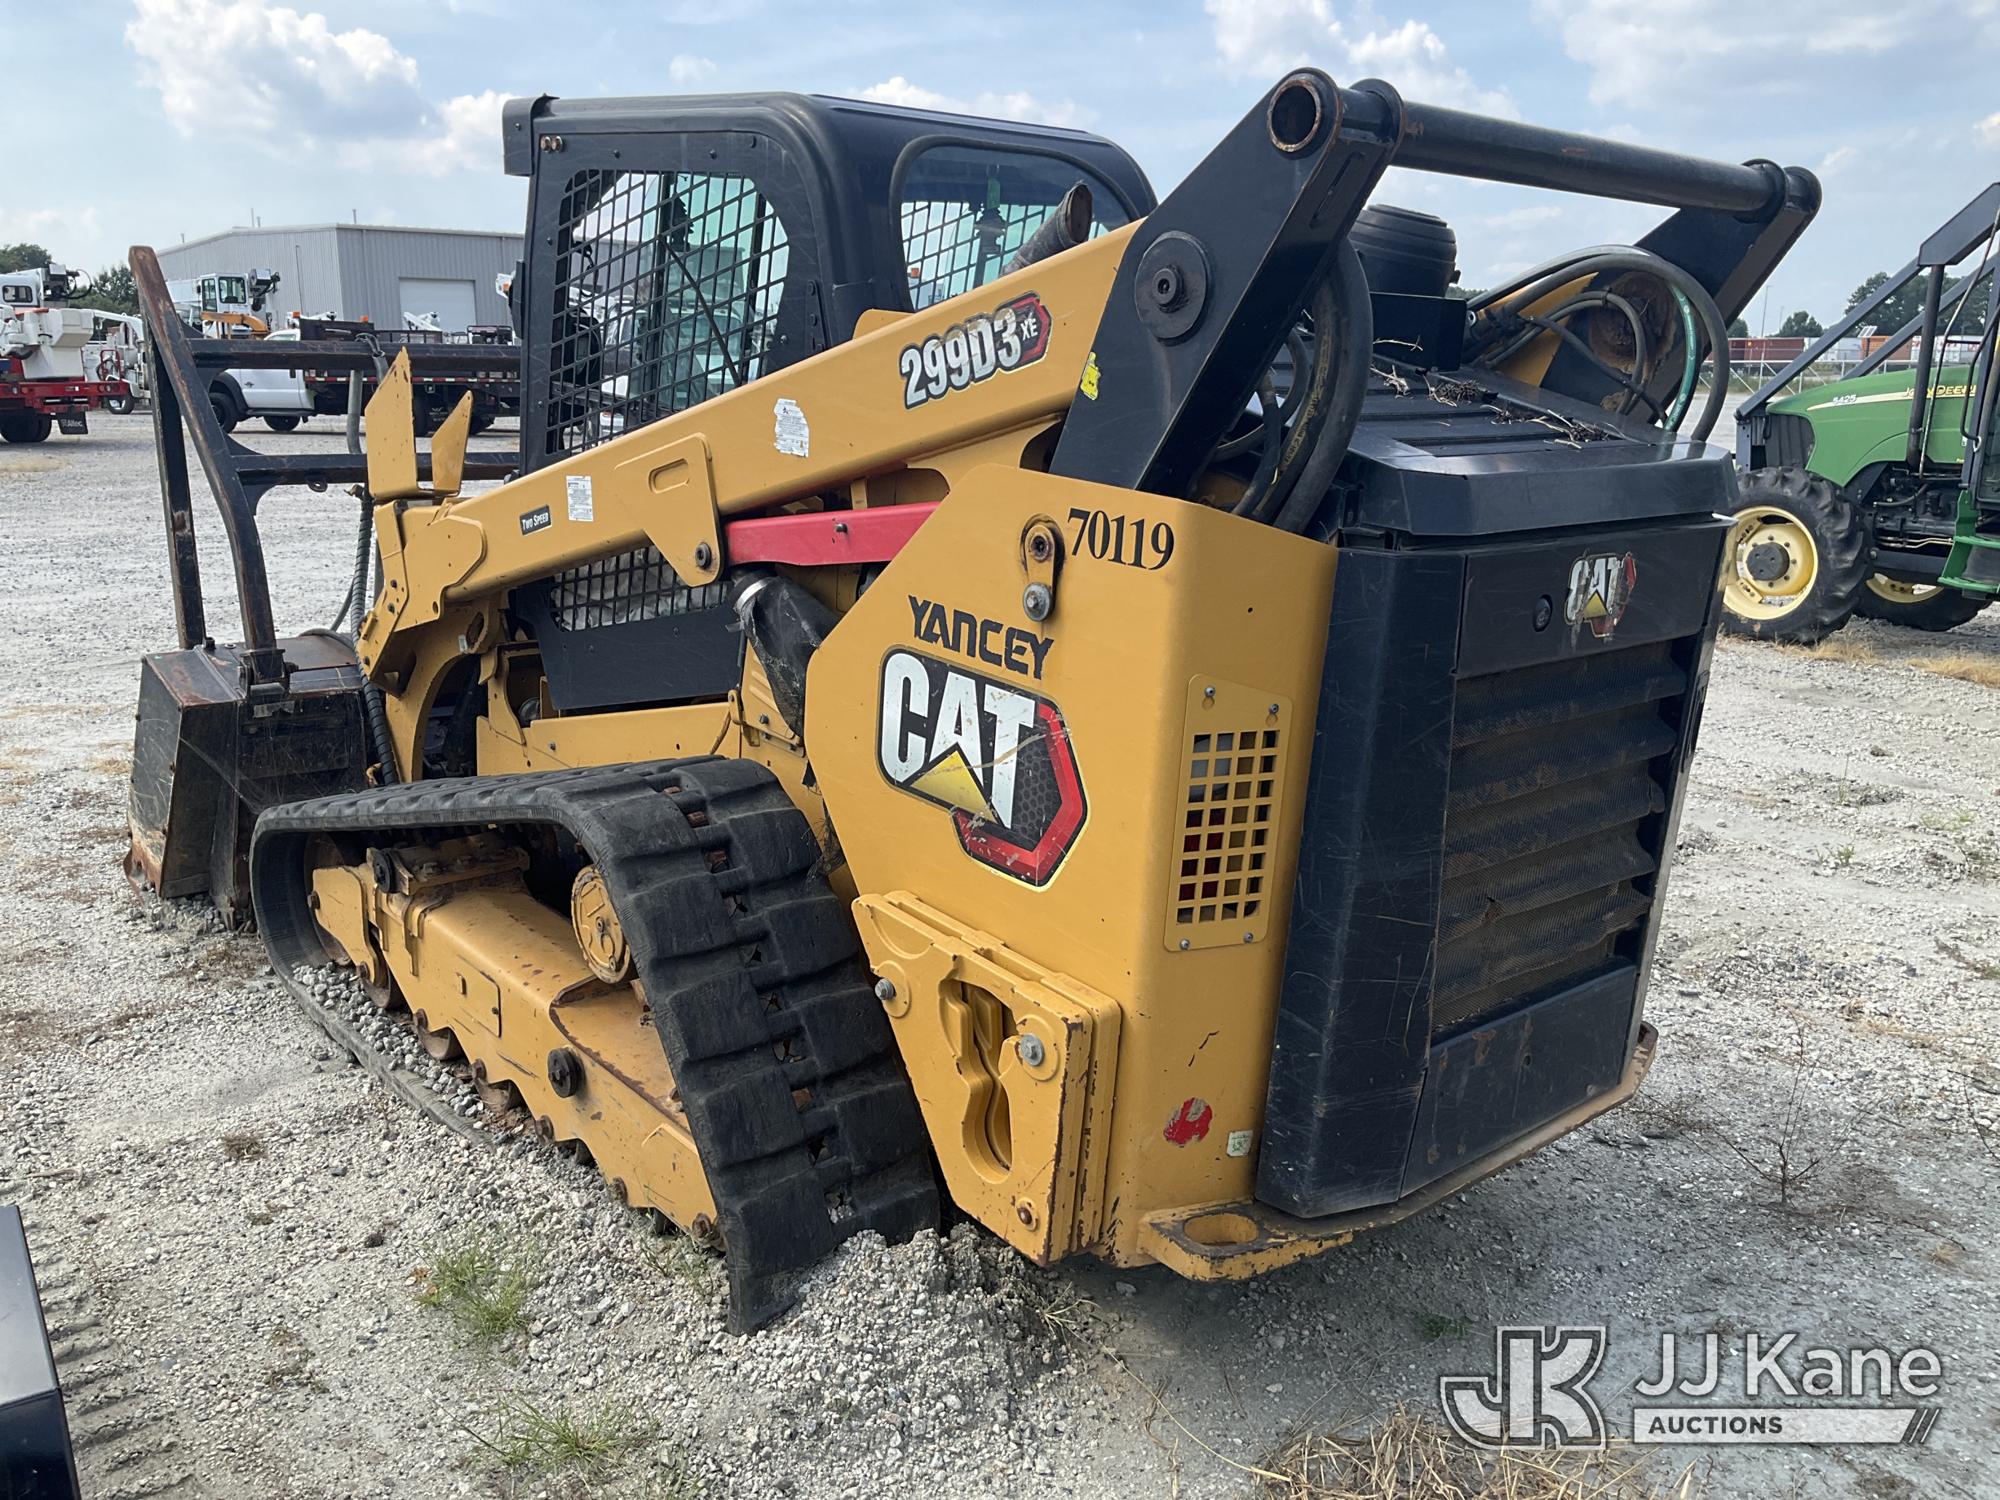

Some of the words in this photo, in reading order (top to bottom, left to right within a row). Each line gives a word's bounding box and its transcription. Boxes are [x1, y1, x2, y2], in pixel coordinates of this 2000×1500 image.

[901, 307, 1021, 406] 299D3
[1020, 311, 1039, 341] XE
[1833, 394, 1857, 405] 5425
[1067, 508, 1175, 571] 70119
[1567, 556, 1621, 621] CAT
[908, 595, 1055, 681] YANCEY
[882, 652, 1036, 830] CAT
